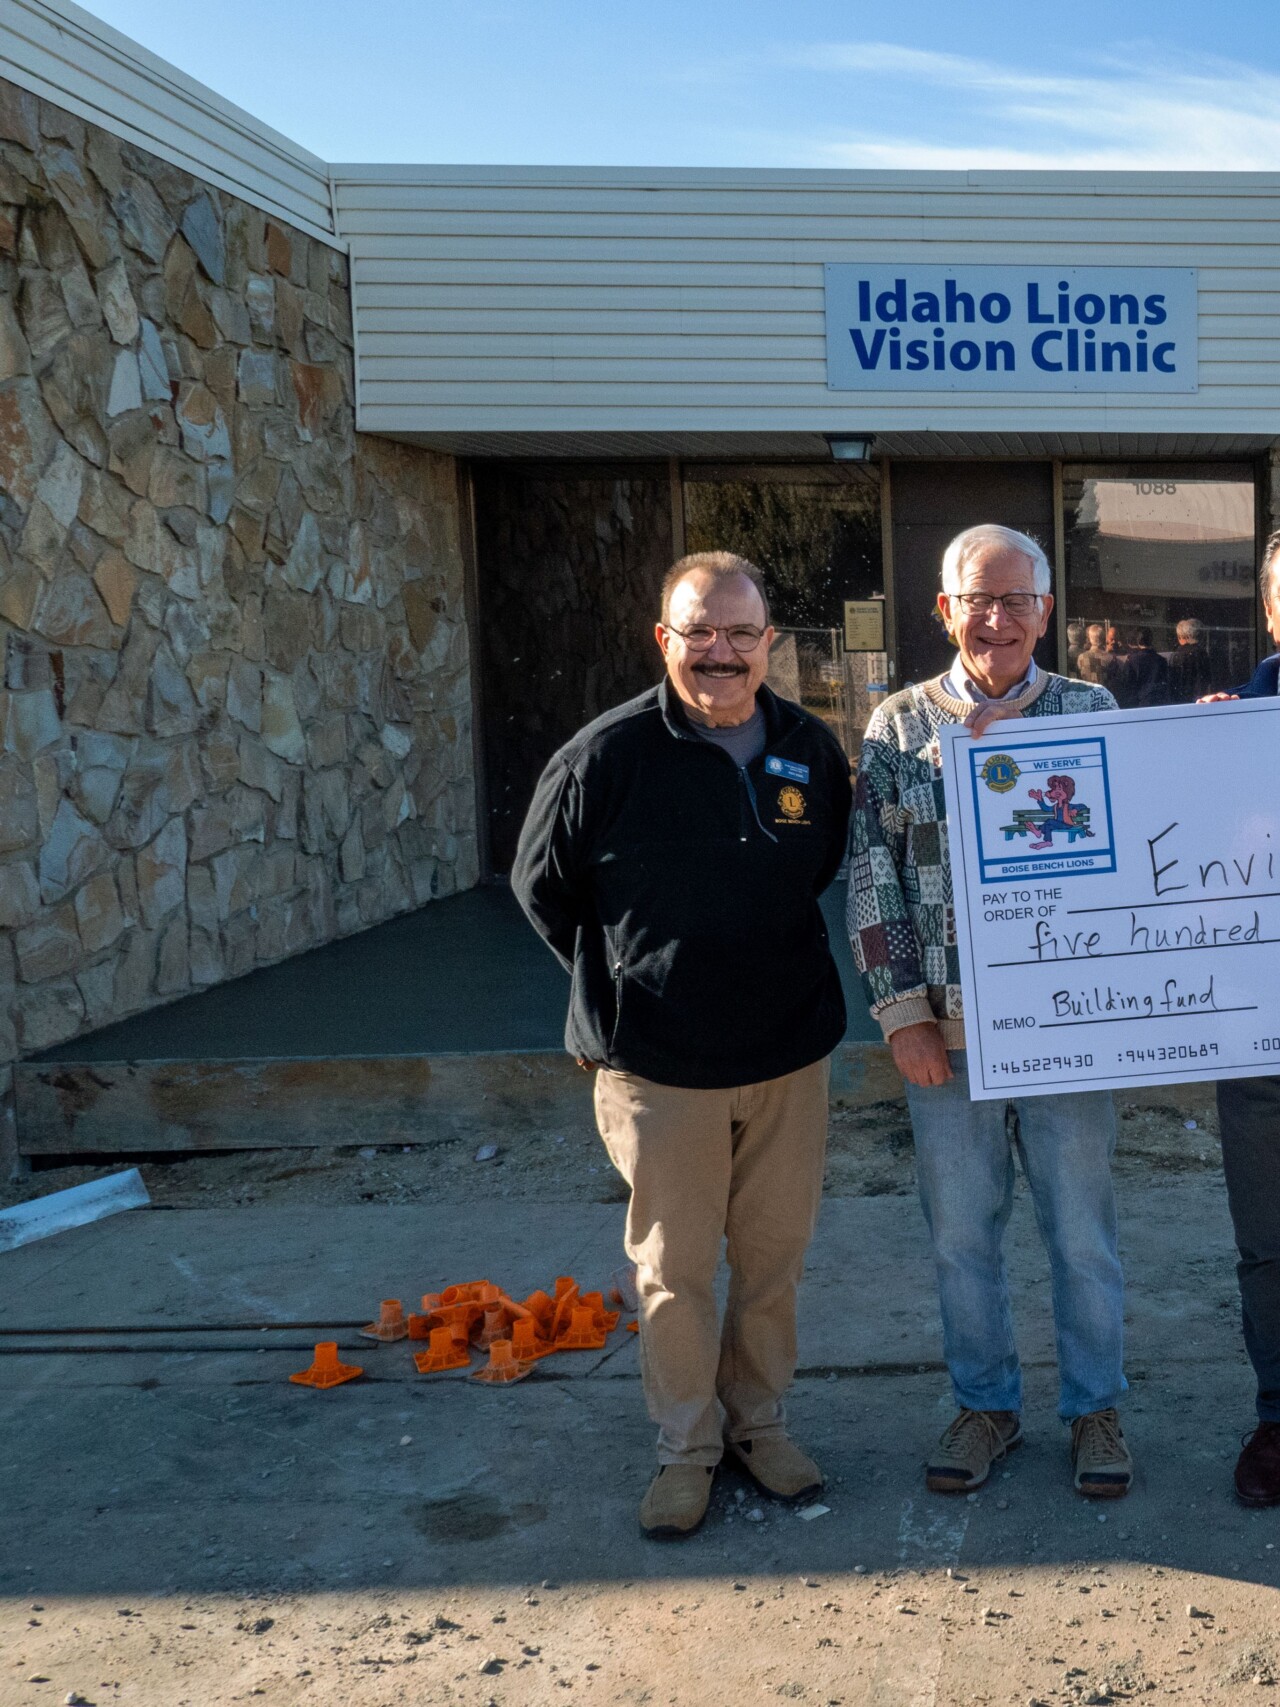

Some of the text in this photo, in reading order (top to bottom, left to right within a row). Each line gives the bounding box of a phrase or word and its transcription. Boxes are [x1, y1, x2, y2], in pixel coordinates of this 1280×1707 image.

[858, 279, 1167, 325] Idaho Lions
[849, 327, 1176, 373] Vision Clinic
[1132, 481, 1176, 496] 1088
[1033, 759, 1081, 769] WE SERVE
[1002, 858, 1094, 874] BOISE BENCH LIONS
[982, 888, 1062, 905] PAY TO THE
[984, 905, 1056, 922] ORDER OF
[1028, 920, 1103, 961] five
[1130, 911, 1262, 952] hundred
[1052, 975, 1220, 1017] Building fund
[993, 1016, 1036, 1030] MEMO
